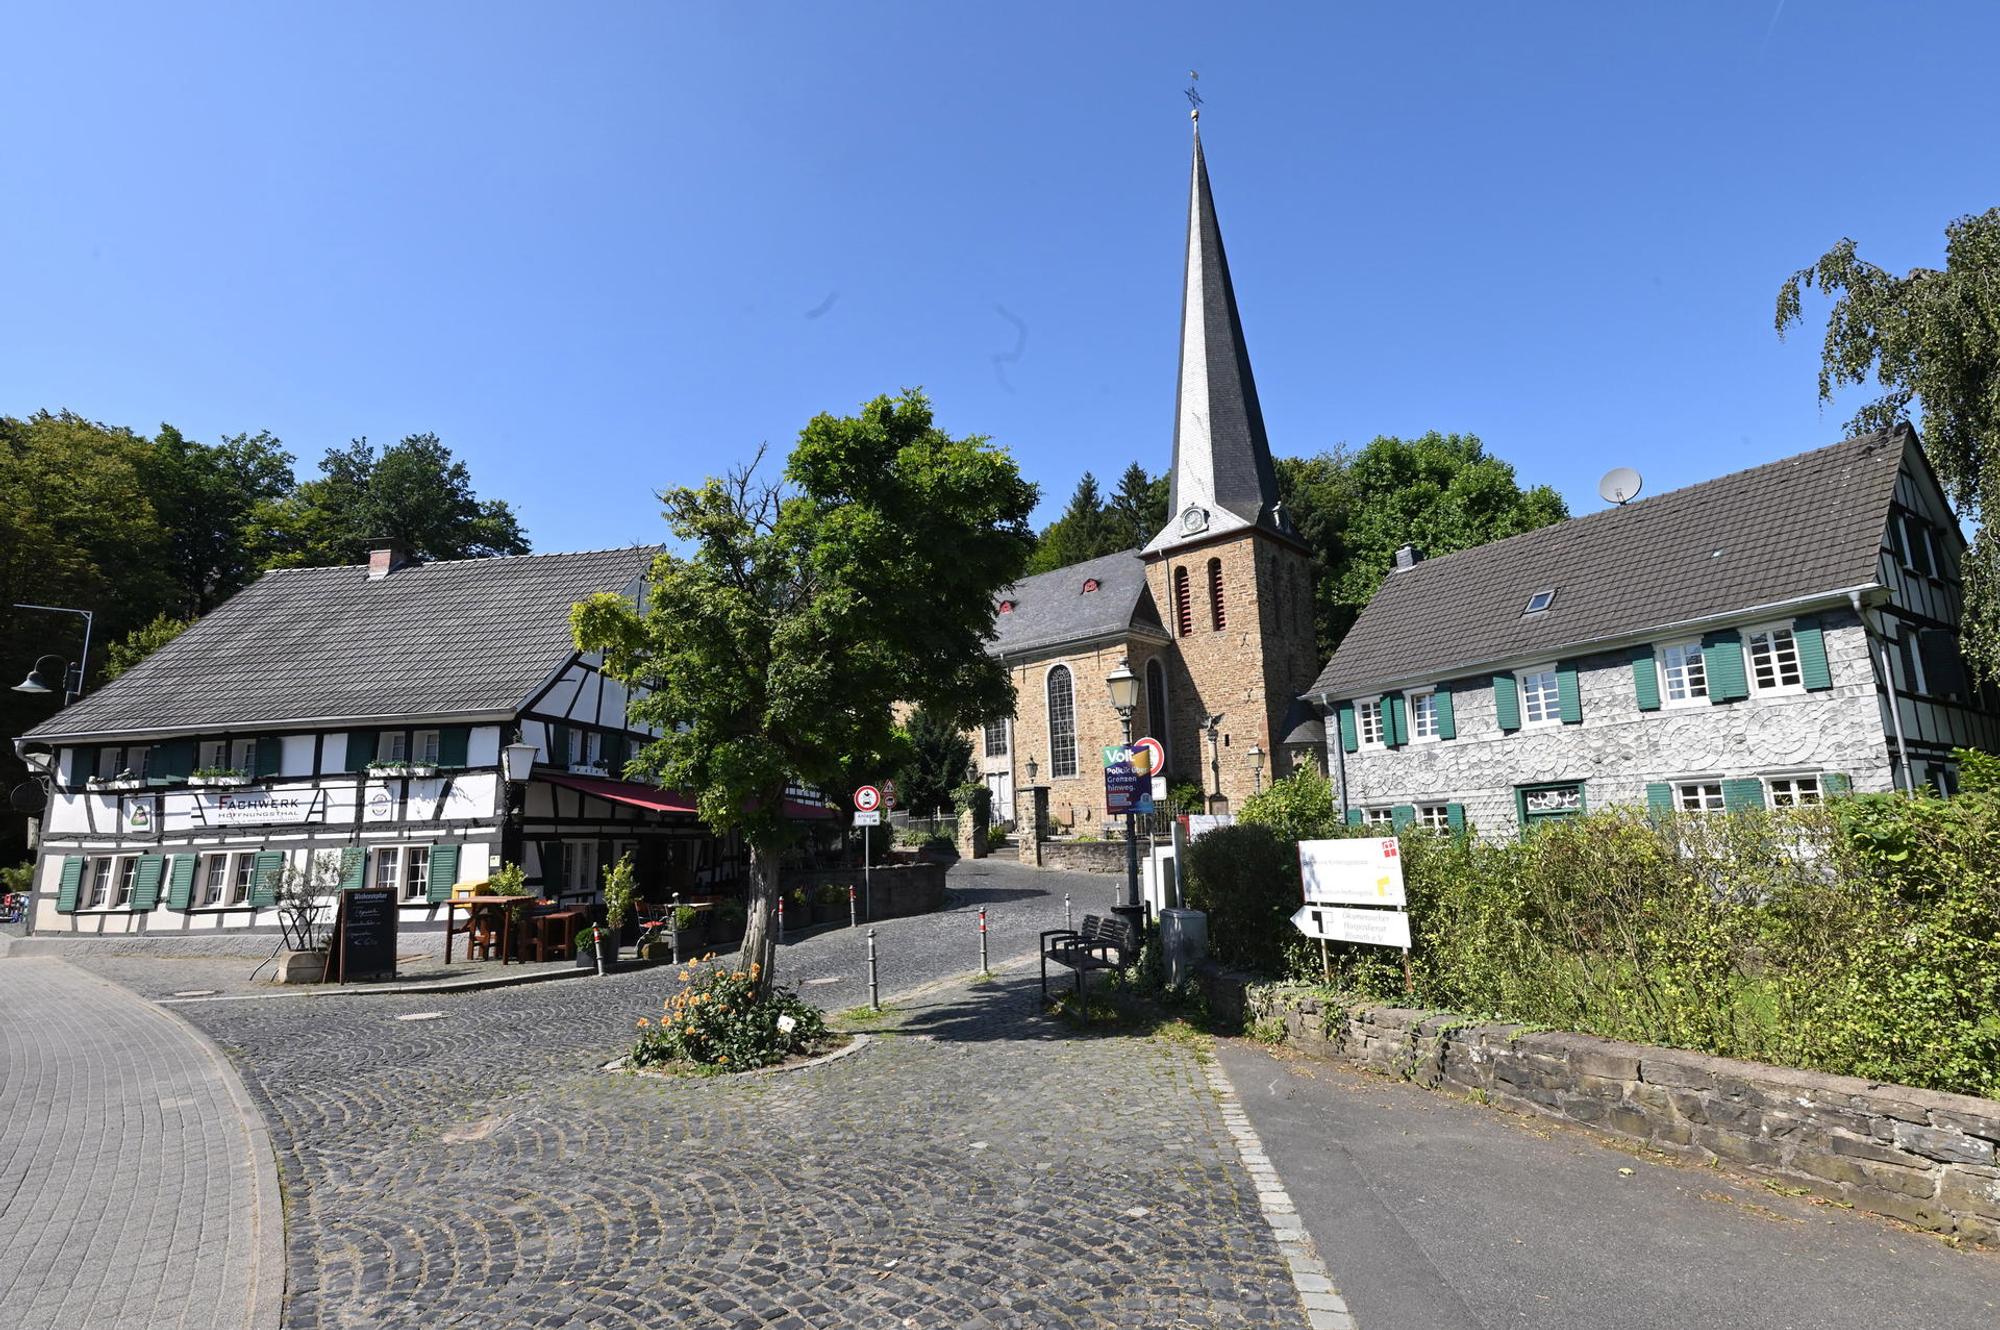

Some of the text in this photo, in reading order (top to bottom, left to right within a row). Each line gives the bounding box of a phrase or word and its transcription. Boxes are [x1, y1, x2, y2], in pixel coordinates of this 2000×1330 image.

[1106, 749, 1135, 763] Volt
[1106, 767, 1130, 775] Politik
[1107, 784, 1136, 792] hinweg.
[218, 795, 299, 810] FACHWERK
